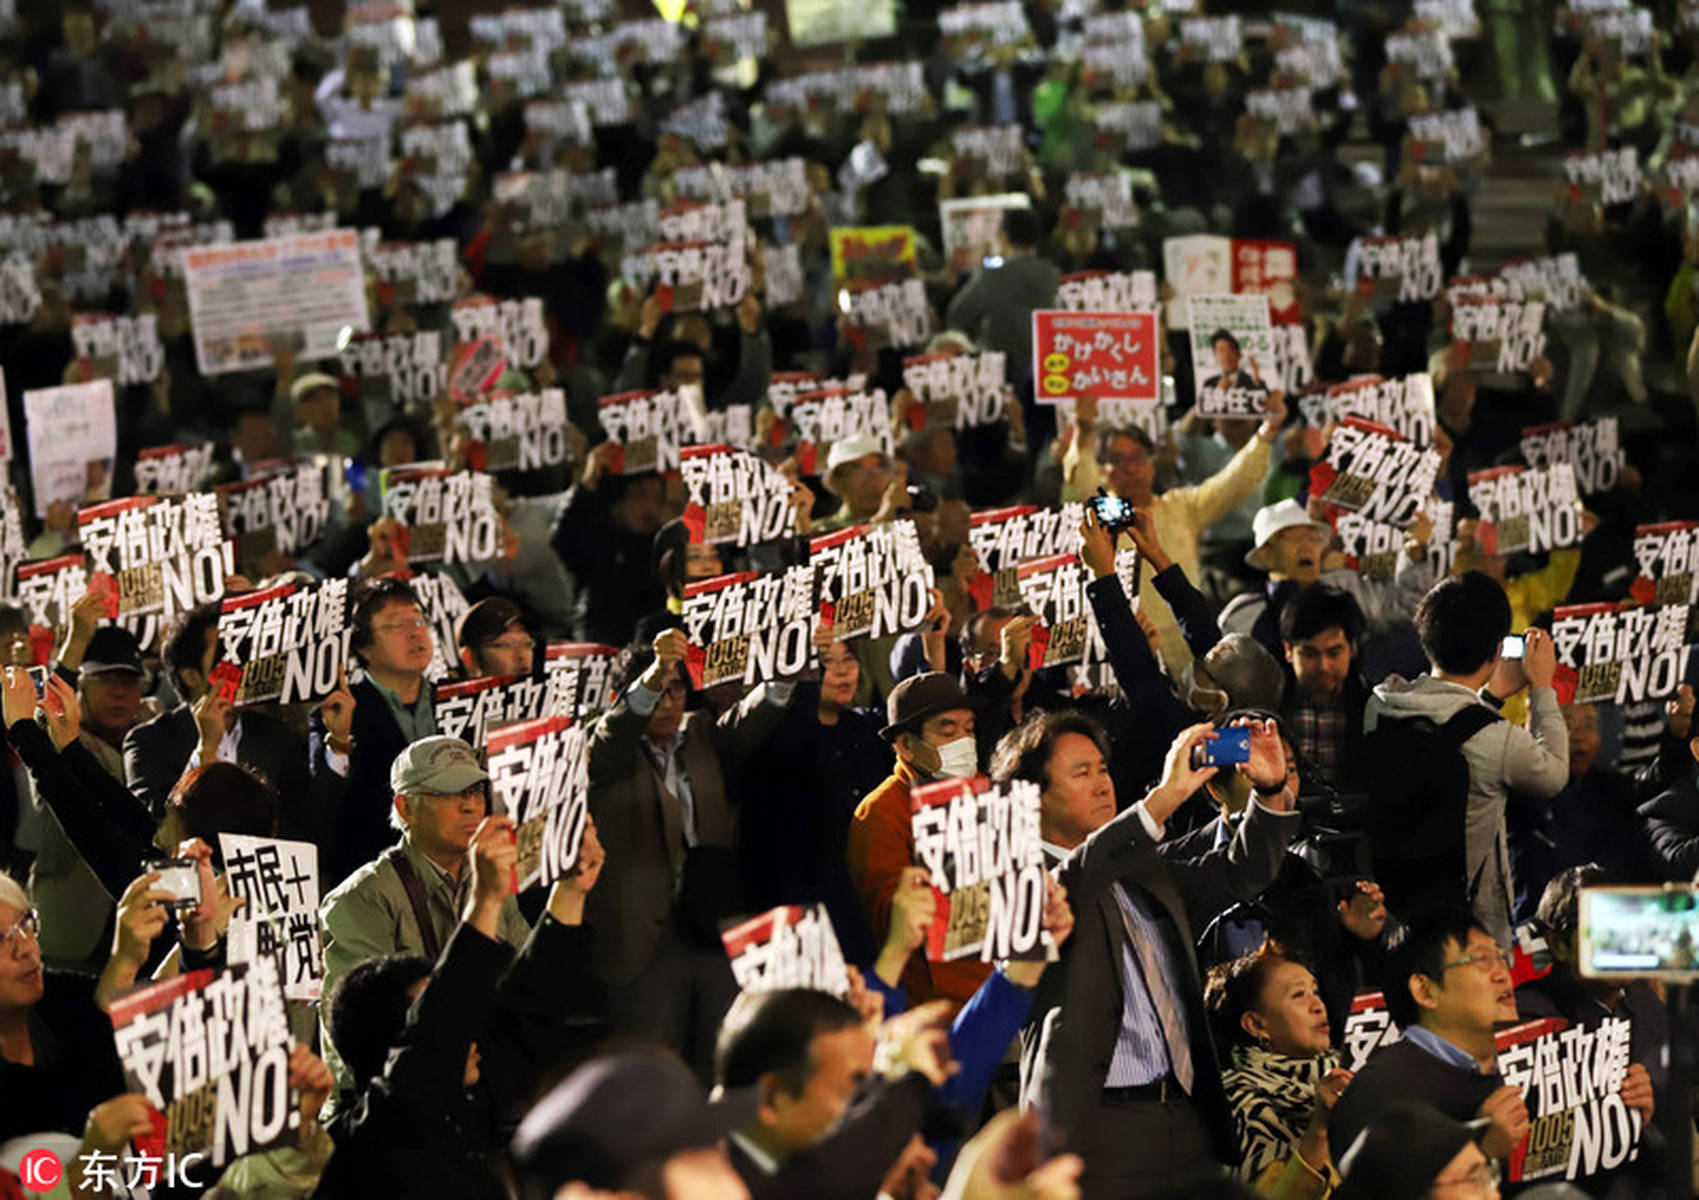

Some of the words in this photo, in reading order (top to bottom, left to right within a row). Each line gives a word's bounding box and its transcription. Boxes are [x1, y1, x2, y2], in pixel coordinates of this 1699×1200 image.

[1053, 331, 1141, 362] かけかくし
[1072, 364, 1149, 391] かいさん
[78, 493, 222, 575] 安倍政権
[738, 495, 797, 547] NO!
[161, 540, 235, 612] NO!
[809, 519, 928, 603] 安倍政権
[218, 578, 349, 666] 安倍政権
[682, 566, 814, 646] 安倍政権
[1552, 604, 1690, 668] 安倍政権
[704, 633, 750, 668] 1005
[743, 612, 820, 686] NO!
[911, 779, 1044, 894] 安倍政権
[114, 953, 294, 1111] 安倍政権
[1497, 1017, 1632, 1119] 安倍政権
[1527, 1107, 1575, 1153] 1005
[1566, 1092, 1642, 1181] NO!
